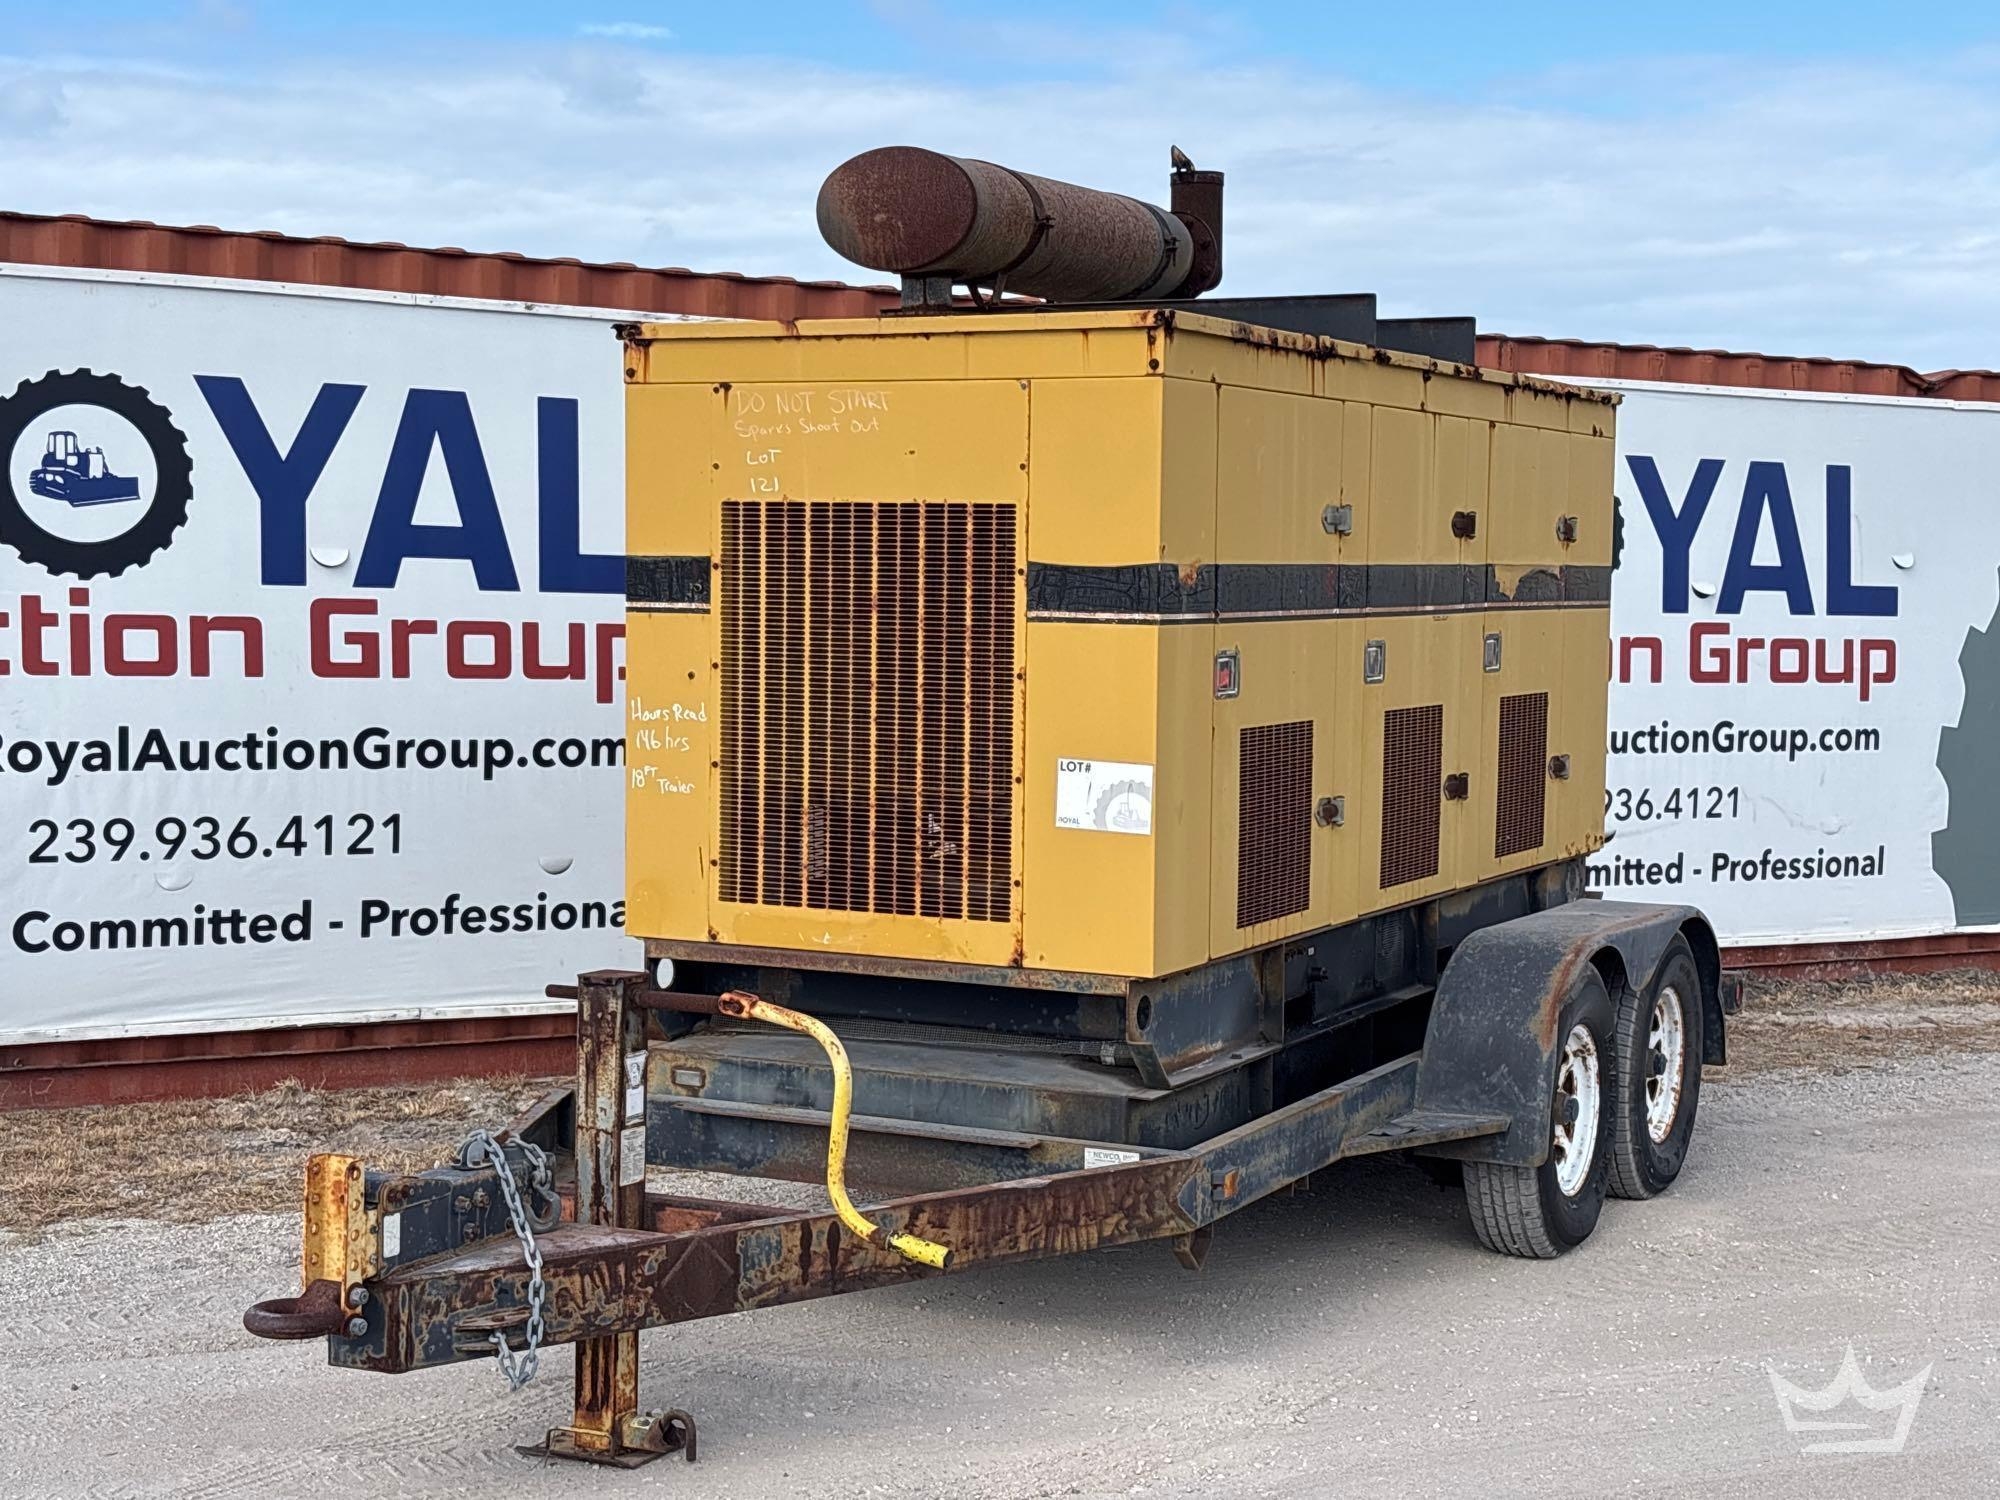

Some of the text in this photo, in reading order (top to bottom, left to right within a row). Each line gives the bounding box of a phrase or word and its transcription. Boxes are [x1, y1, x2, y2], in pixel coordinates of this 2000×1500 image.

[736, 389, 893, 416] DO NOT START
[850, 416, 880, 433] Out
[750, 476, 779, 493] 121
[0, 587, 264, 677] tion
[1608, 622, 1897, 702] n Group
[672, 701, 707, 722] Read
[0, 726, 625, 786] oyalAuctionGroup.com
[665, 726, 690, 751] hrs
[1607, 720, 1881, 762] uctionGroup.com
[28, 813, 402, 864] 239.936.4121
[1711, 845, 1886, 882] Professional
[12, 900, 313, 954] Committed
